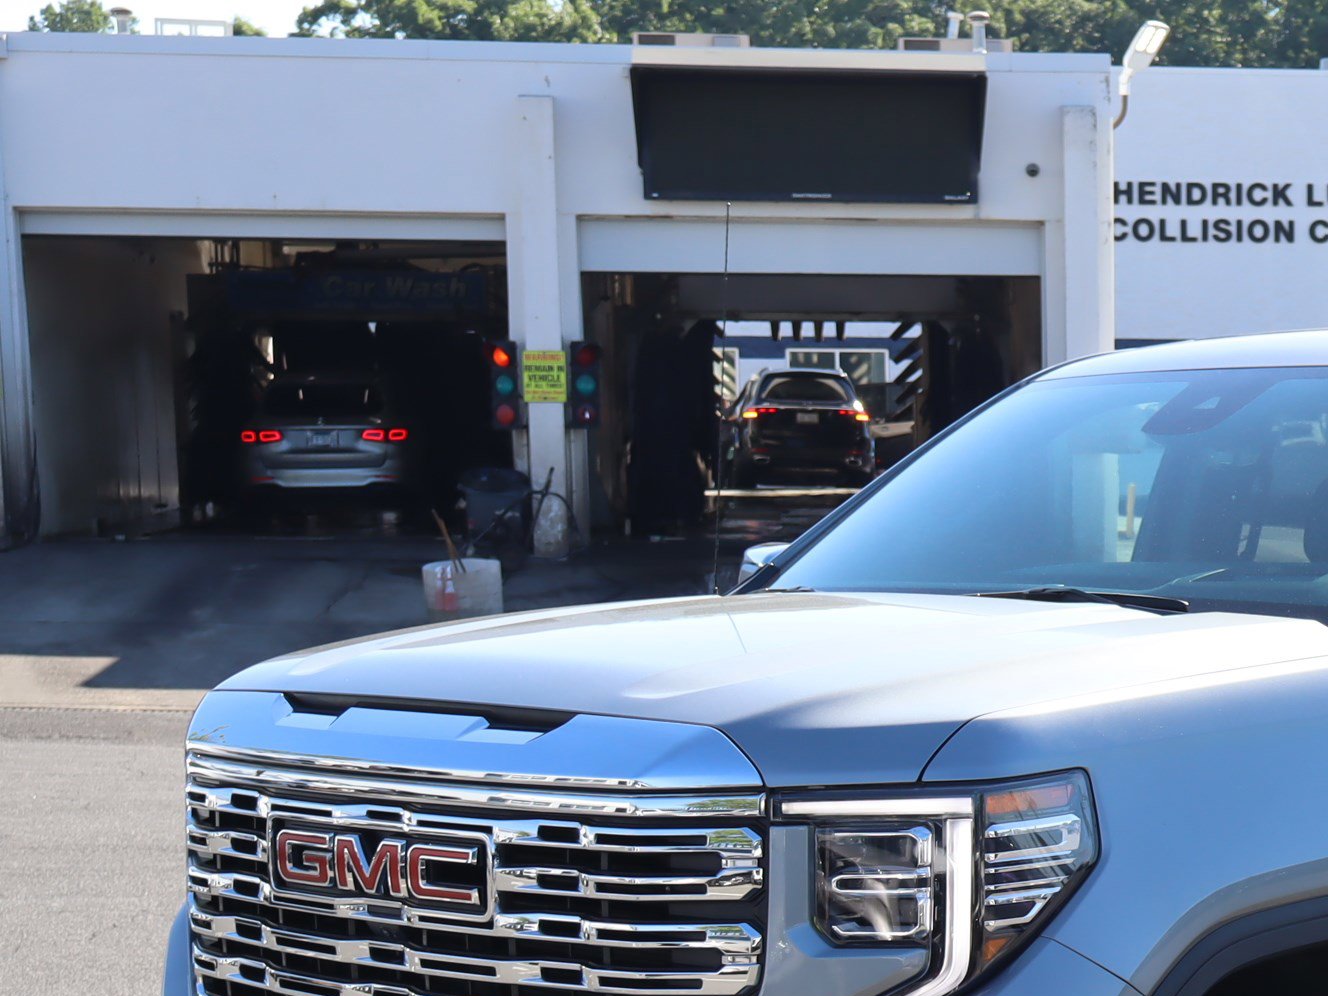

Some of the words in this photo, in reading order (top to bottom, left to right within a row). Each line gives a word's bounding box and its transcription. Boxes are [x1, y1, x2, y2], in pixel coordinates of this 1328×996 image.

[1113, 182, 1294, 207] HENDRICK
[1113, 218, 1296, 243] COLLISION
[322, 275, 376, 298] Car
[385, 275, 467, 299] Wash
[277, 829, 480, 905] GMC
